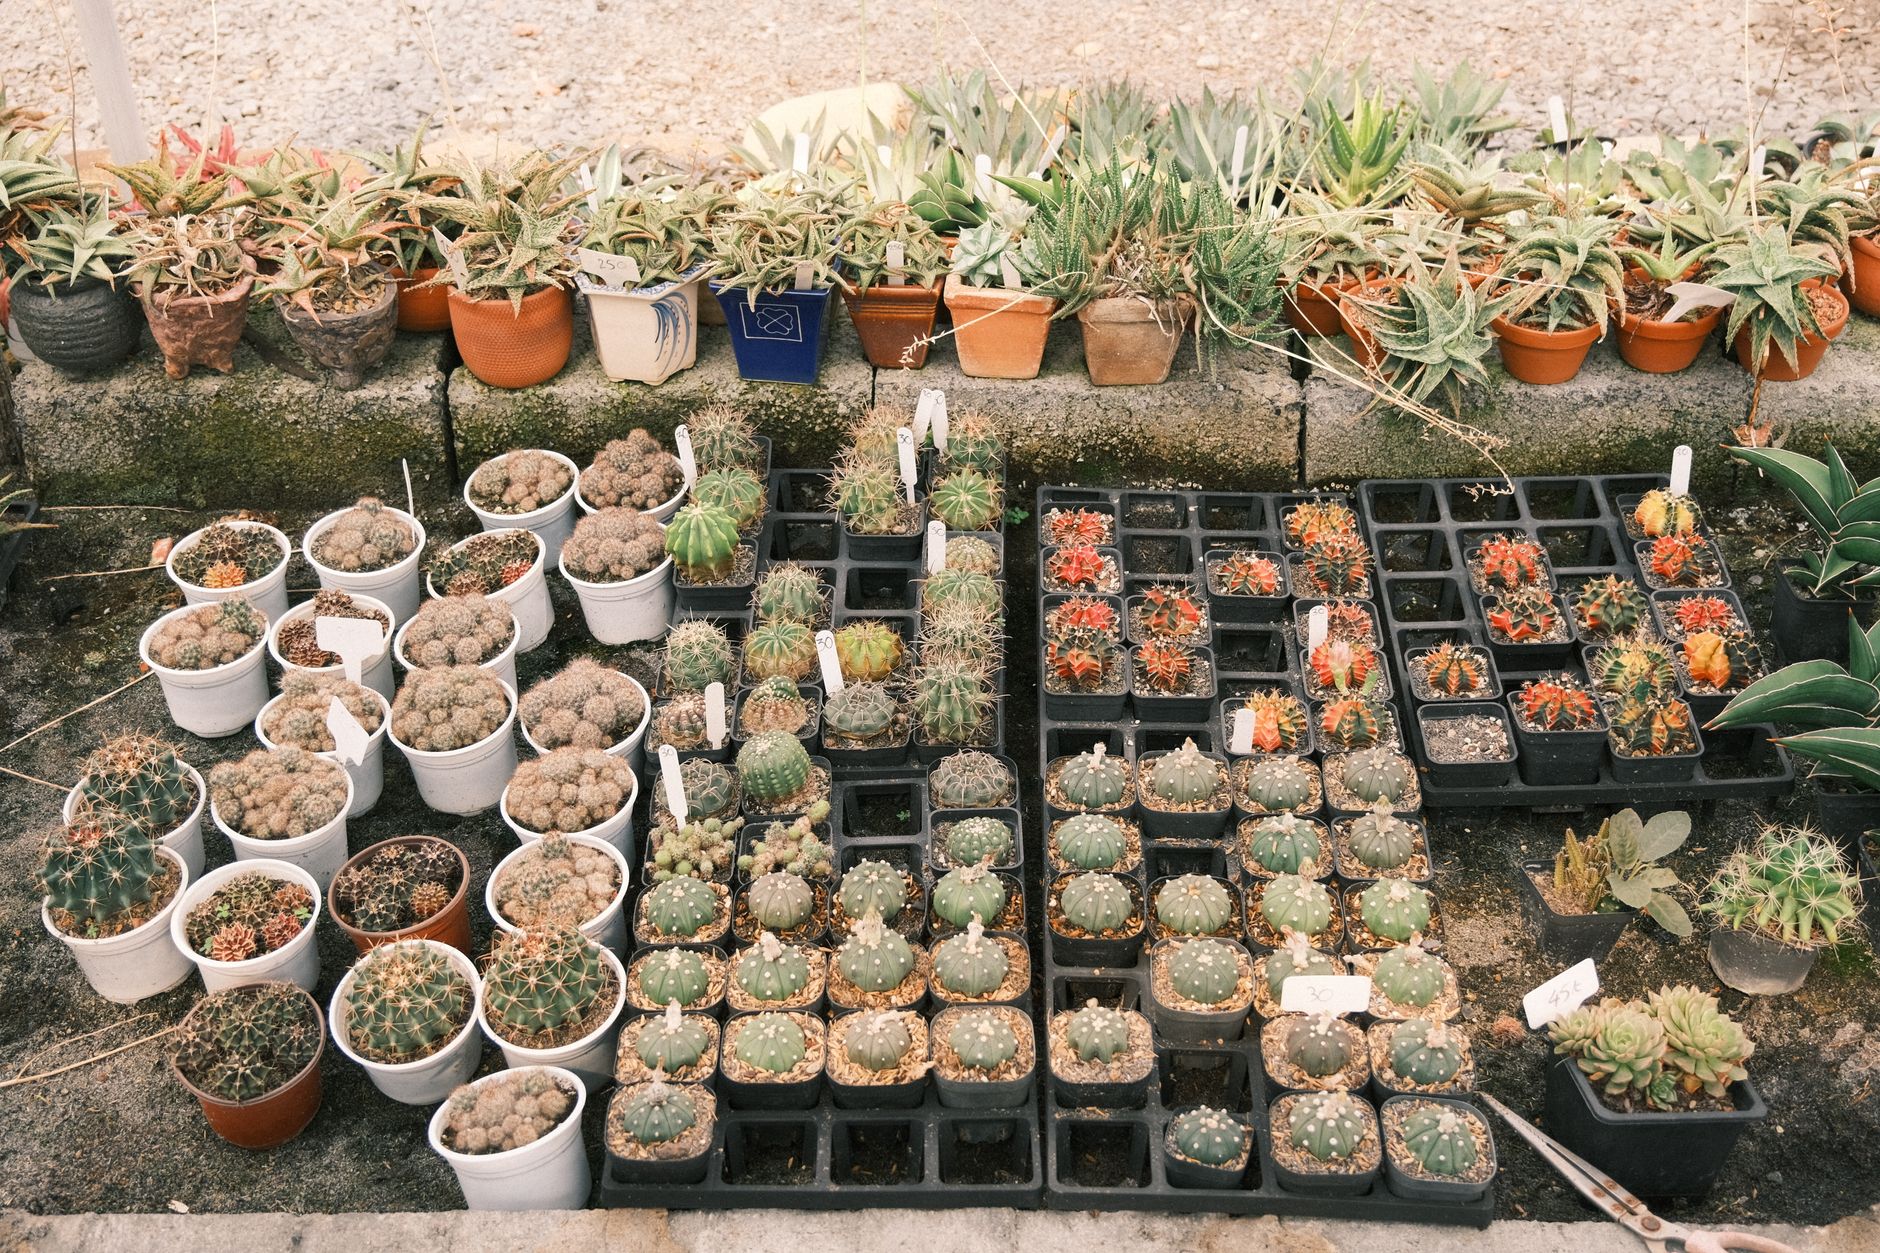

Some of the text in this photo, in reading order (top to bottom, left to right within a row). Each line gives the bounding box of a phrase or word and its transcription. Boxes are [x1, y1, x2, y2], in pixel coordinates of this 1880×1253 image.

[598, 258, 627, 270] 250
[899, 433, 913, 445] 30
[816, 636, 834, 651] 30
[1306, 986, 1334, 1002] 30
